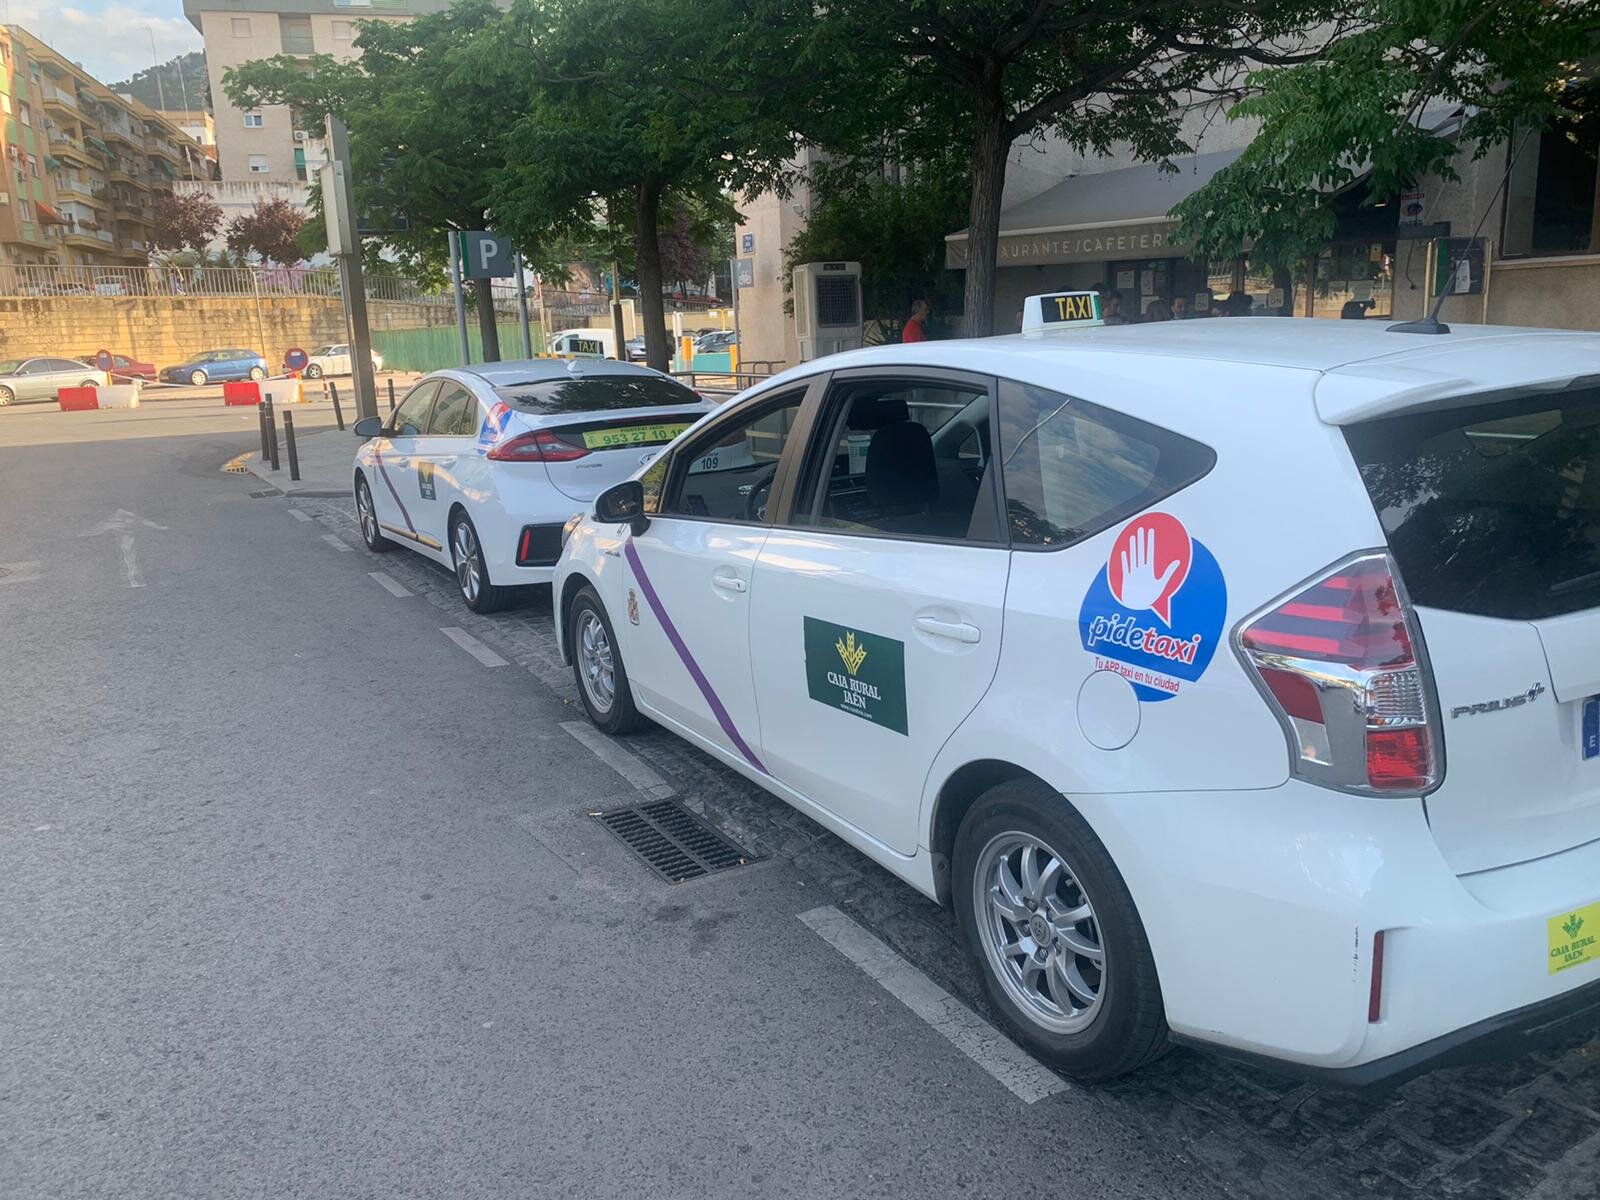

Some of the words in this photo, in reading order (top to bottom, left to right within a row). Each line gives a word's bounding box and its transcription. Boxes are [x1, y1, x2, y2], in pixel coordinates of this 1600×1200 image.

[479, 240, 498, 269] P
[1055, 294, 1093, 321] TAXI
[577, 340, 599, 353] TAXI
[603, 433, 628, 445] 953
[632, 432, 646, 441] 27
[653, 430, 667, 440] 10
[700, 457, 719, 470] 109
[1088, 613, 1202, 665] pidetaxi
[827, 671, 849, 689] CAJA
[849, 679, 881, 700] RURAL
[1094, 656, 1104, 669] Tu
[1104, 660, 1120, 674] APP
[1120, 665, 1135, 680] taxi
[1134, 671, 1144, 683] en
[1144, 673, 1153, 685] tu
[1153, 676, 1180, 693] ciudad
[1589, 735, 1596, 748] E
